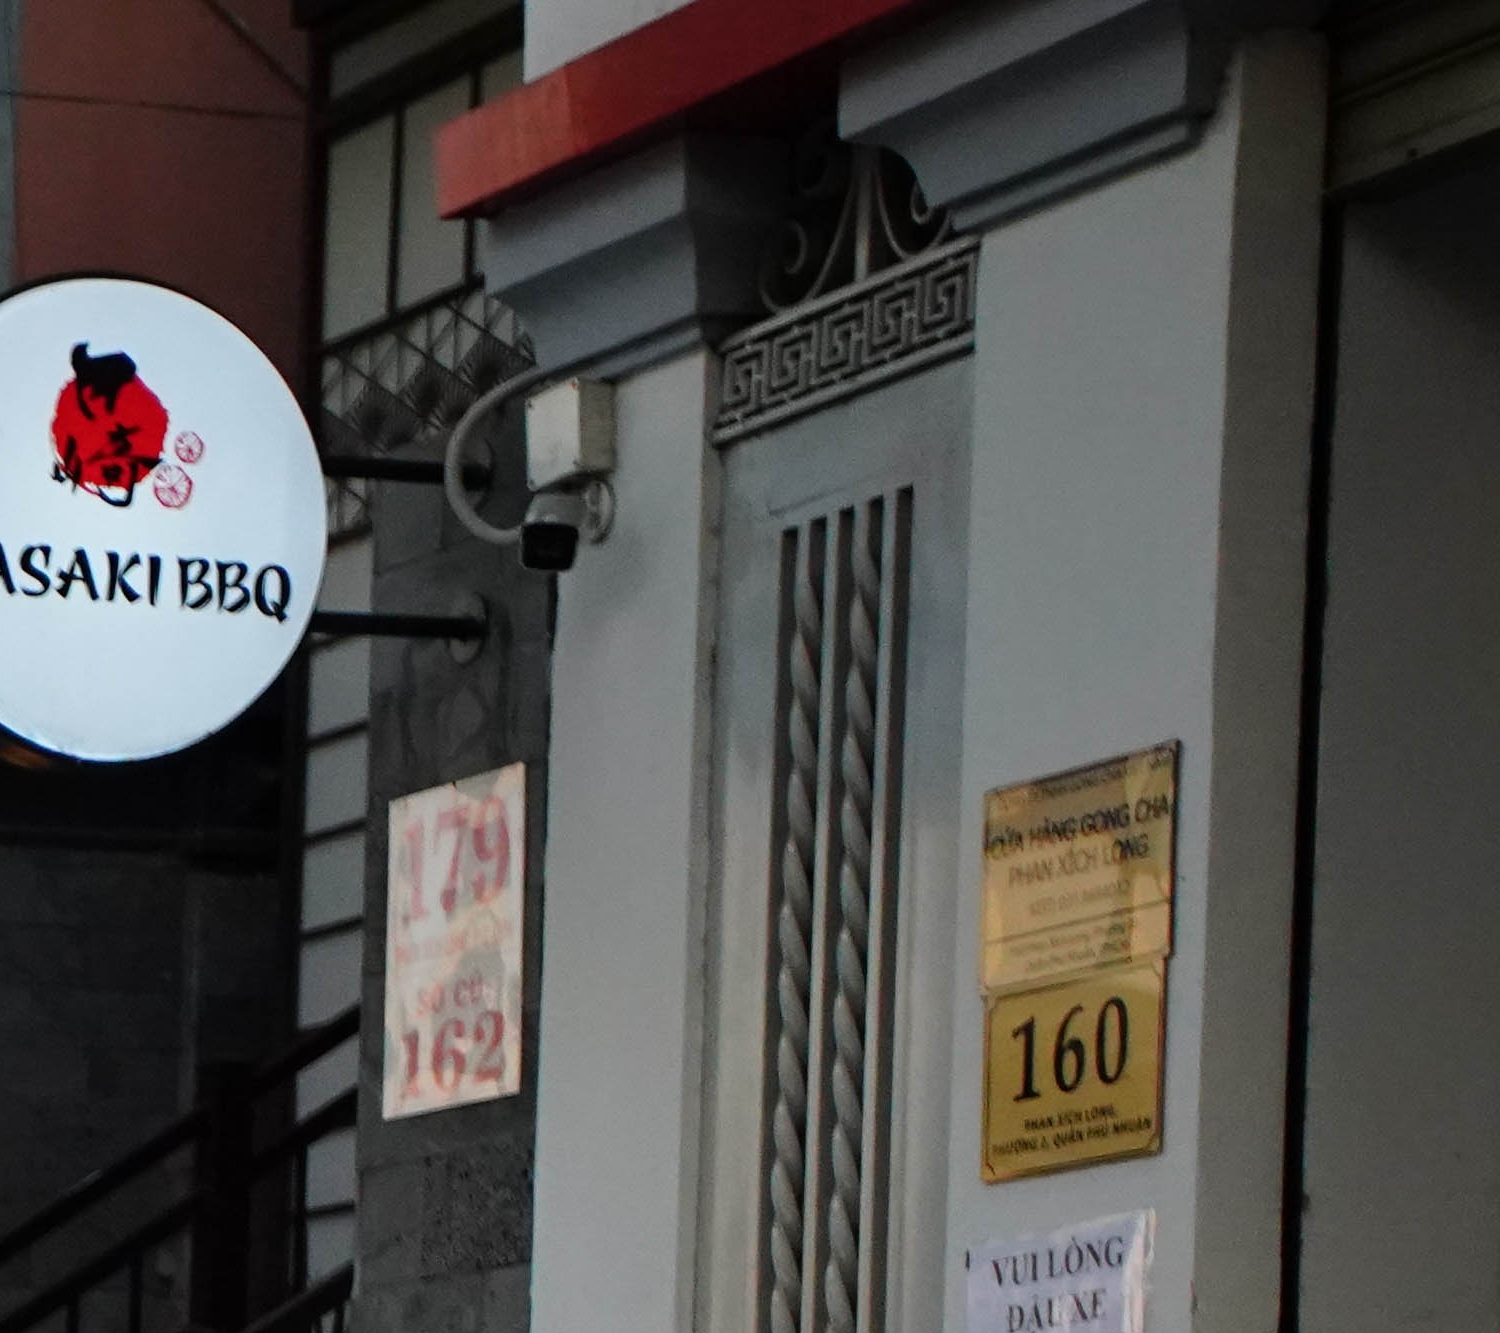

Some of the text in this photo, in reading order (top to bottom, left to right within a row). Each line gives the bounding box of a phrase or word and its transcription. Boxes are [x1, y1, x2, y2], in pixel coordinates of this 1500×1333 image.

[177, 555, 291, 623] BBQ
[405, 797, 511, 922] 179
[402, 1009, 506, 1098] 162
[1012, 995, 1129, 1103] 160
[991, 1235, 1125, 1287] VUI LÒNG
[1069, 1288, 1108, 1323] XE
